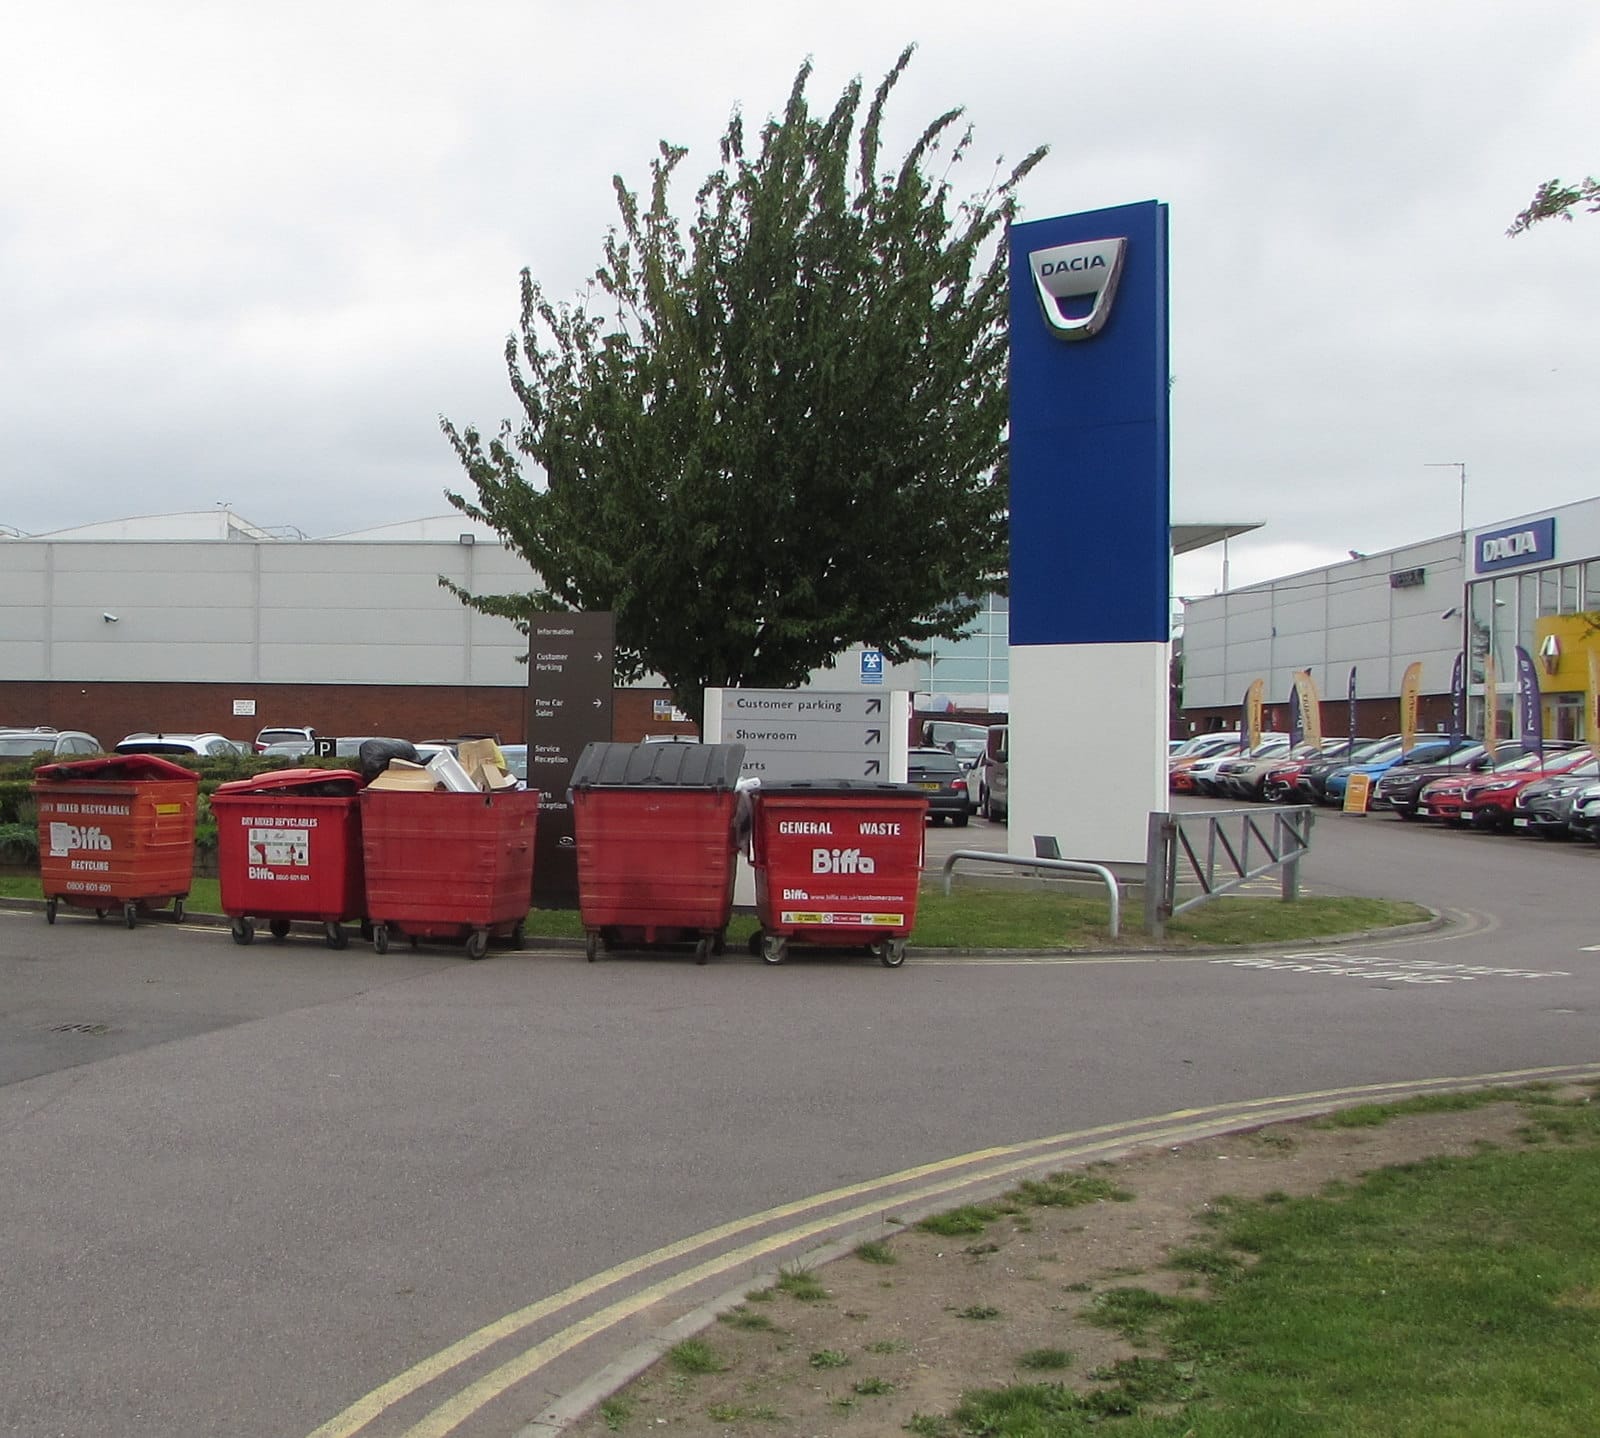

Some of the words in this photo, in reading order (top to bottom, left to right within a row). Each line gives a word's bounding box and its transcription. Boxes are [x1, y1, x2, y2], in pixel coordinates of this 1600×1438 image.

[1041, 255, 1106, 276] DACIA
[536, 664, 562, 672] Parking
[737, 698, 793, 709] Customer
[798, 700, 842, 712] parking
[736, 729, 797, 740] Showroom
[320, 742, 330, 757] P
[742, 762, 766, 770] arts
[57, 803, 79, 813] MIXED
[81, 804, 130, 815] RECYCLABLES
[779, 821, 833, 834] GENERAL
[859, 823, 900, 835] WASTE
[71, 860, 109, 870] RECYCLING
[812, 849, 875, 874] Biffa
[248, 867, 274, 879] Biffa
[783, 889, 808, 900] Biffa
